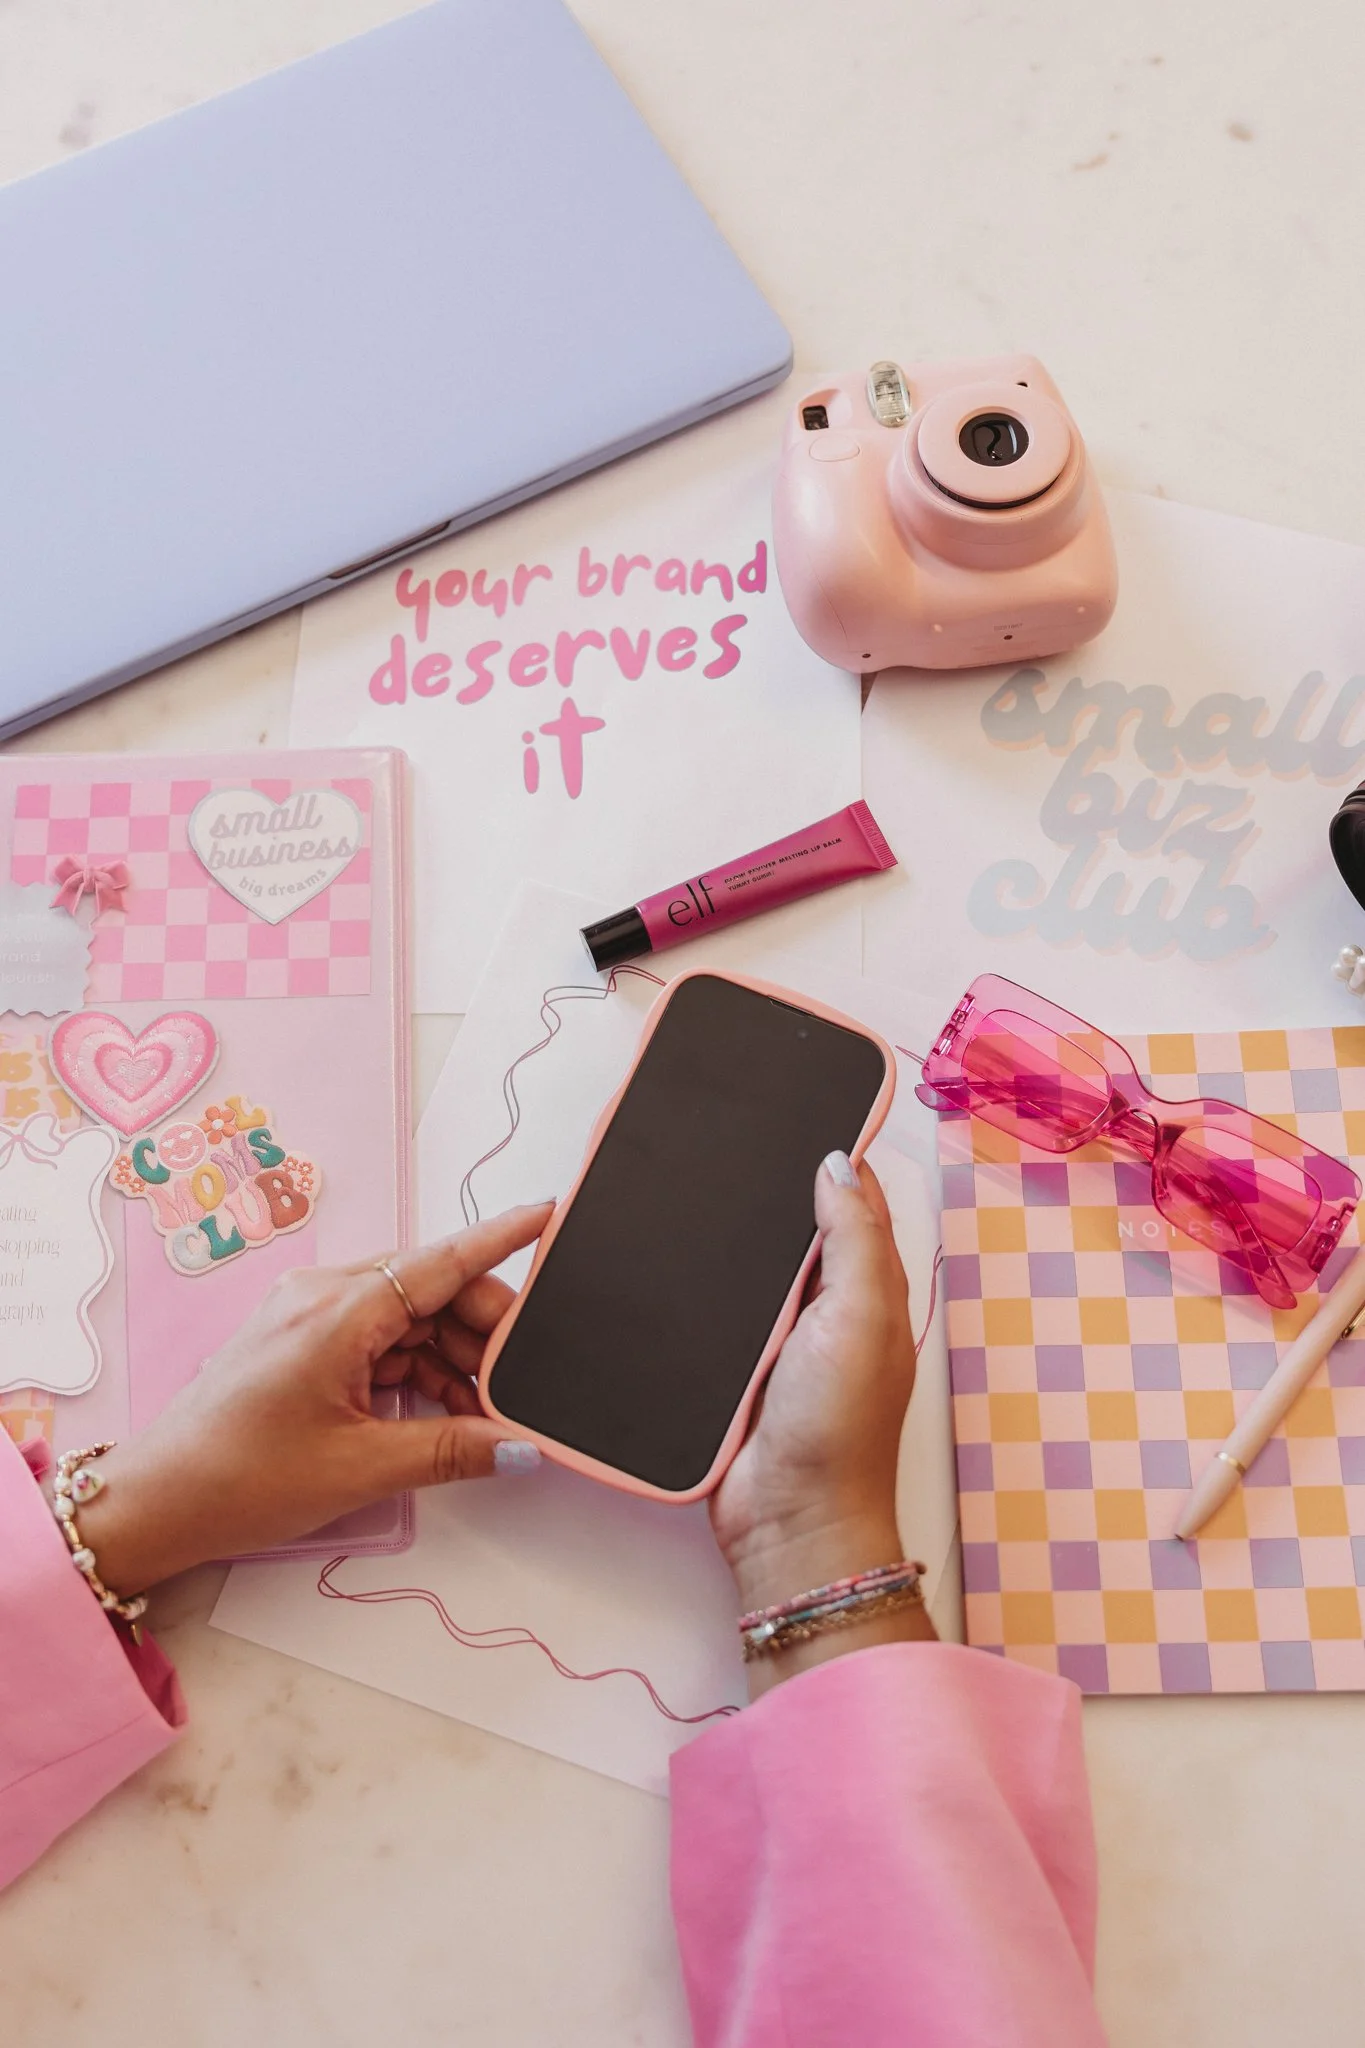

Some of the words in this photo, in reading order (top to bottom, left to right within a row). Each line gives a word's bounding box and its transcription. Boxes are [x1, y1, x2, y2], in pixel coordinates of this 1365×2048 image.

[395, 563, 553, 642] your
[578, 540, 768, 603] brand
[368, 614, 748, 706] deserves
[521, 697, 606, 800] it
[980, 668, 1365, 787] small
[209, 794, 323, 839] small
[1039, 738, 1263, 862] biz
[208, 836, 355, 871] business
[238, 876, 264, 898] big
[268, 868, 327, 897] dreams
[728, 879, 750, 891] YUMMY
[778, 849, 809, 864] MELTING
[810, 845, 821, 853] LIP
[823, 837, 842, 849] BALM
[966, 838, 1278, 962] club
[148, 1128, 286, 1229] MOMS
[173, 1169, 310, 1270] CLUB
[1117, 1221, 1225, 1238] NOTES
